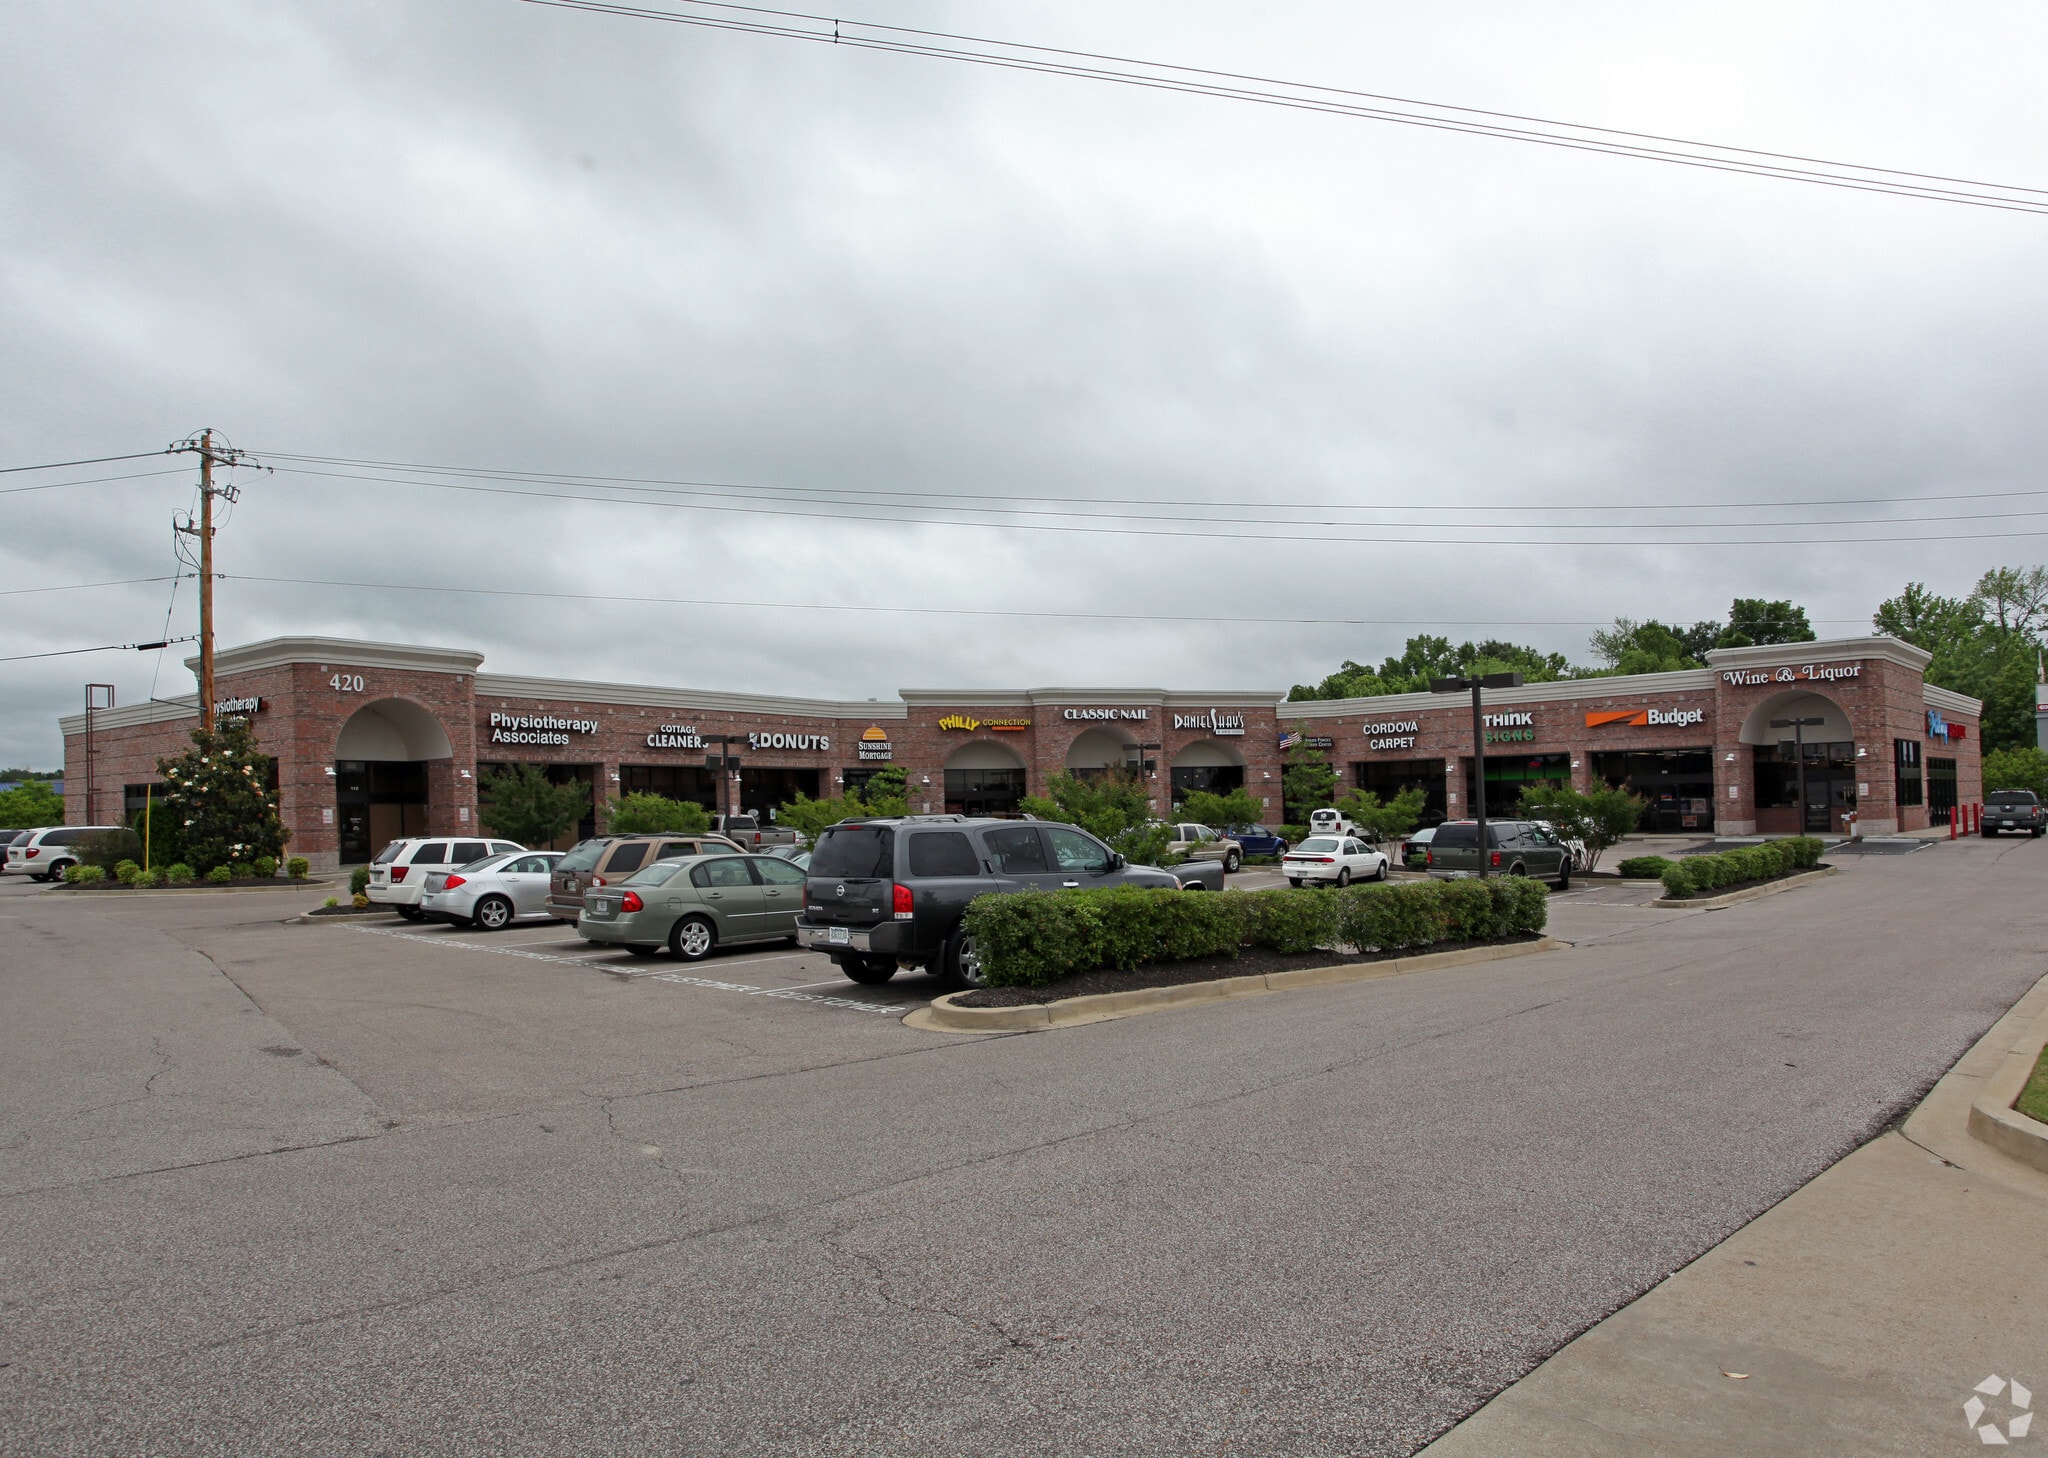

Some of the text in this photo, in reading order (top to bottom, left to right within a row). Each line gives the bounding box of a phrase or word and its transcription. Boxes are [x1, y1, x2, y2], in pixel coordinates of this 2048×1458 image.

[329, 673, 364, 692] 420
[1723, 664, 1861, 686] Wine & Liquor
[214, 696, 259, 717] ysiotherapy
[1064, 709, 1149, 720] CLASSIC NAIL
[490, 712, 598, 734] Physiotherapy
[938, 714, 1031, 731] PHILLY CONNECTION
[1647, 707, 1703, 727] Budget
[491, 728, 569, 745] Associates
[660, 724, 696, 735] COTTAGE
[1363, 721, 1418, 735] CORDOVA
[1485, 729, 1534, 743] SIGNS
[760, 732, 830, 751] DONUTS
[858, 741, 892, 750] SUNSHINE
[1370, 737, 1415, 750] CARPET
[858, 751, 892, 760] MORTGAGE
